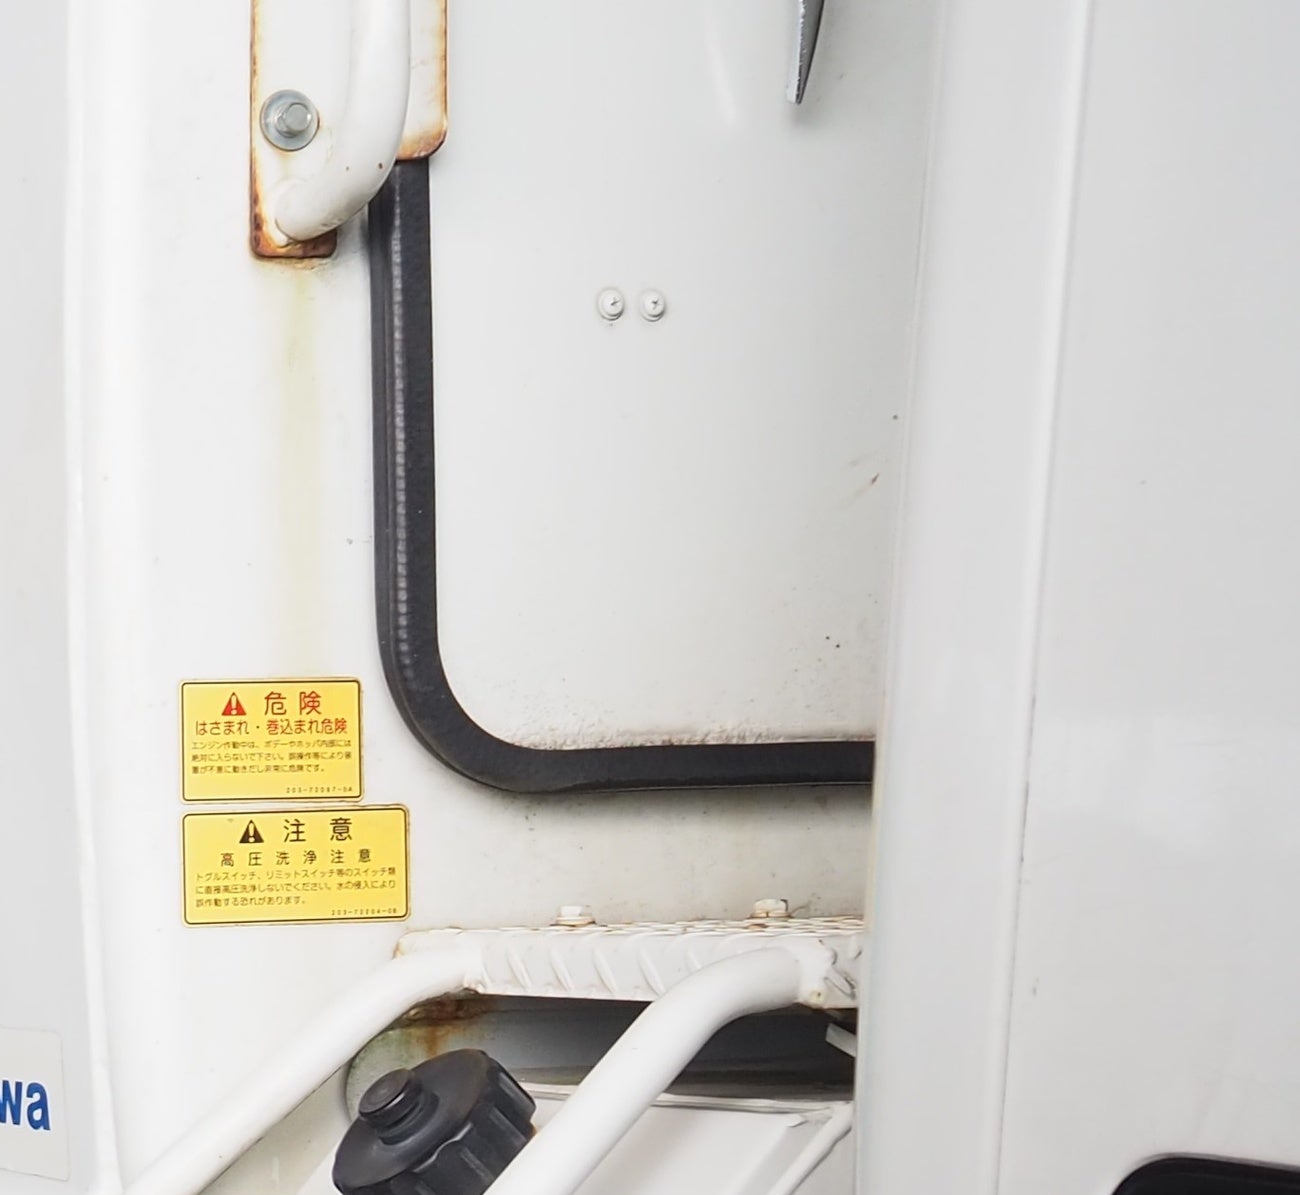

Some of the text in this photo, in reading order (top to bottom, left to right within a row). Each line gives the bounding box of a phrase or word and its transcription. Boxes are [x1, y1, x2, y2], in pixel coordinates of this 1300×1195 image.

[264, 691, 322, 716] 危険
[195, 717, 348, 736] はさまれ・巻込まれ危険
[283, 817, 353, 843] 注意
[220, 848, 372, 868] 高圧洗浄注意
